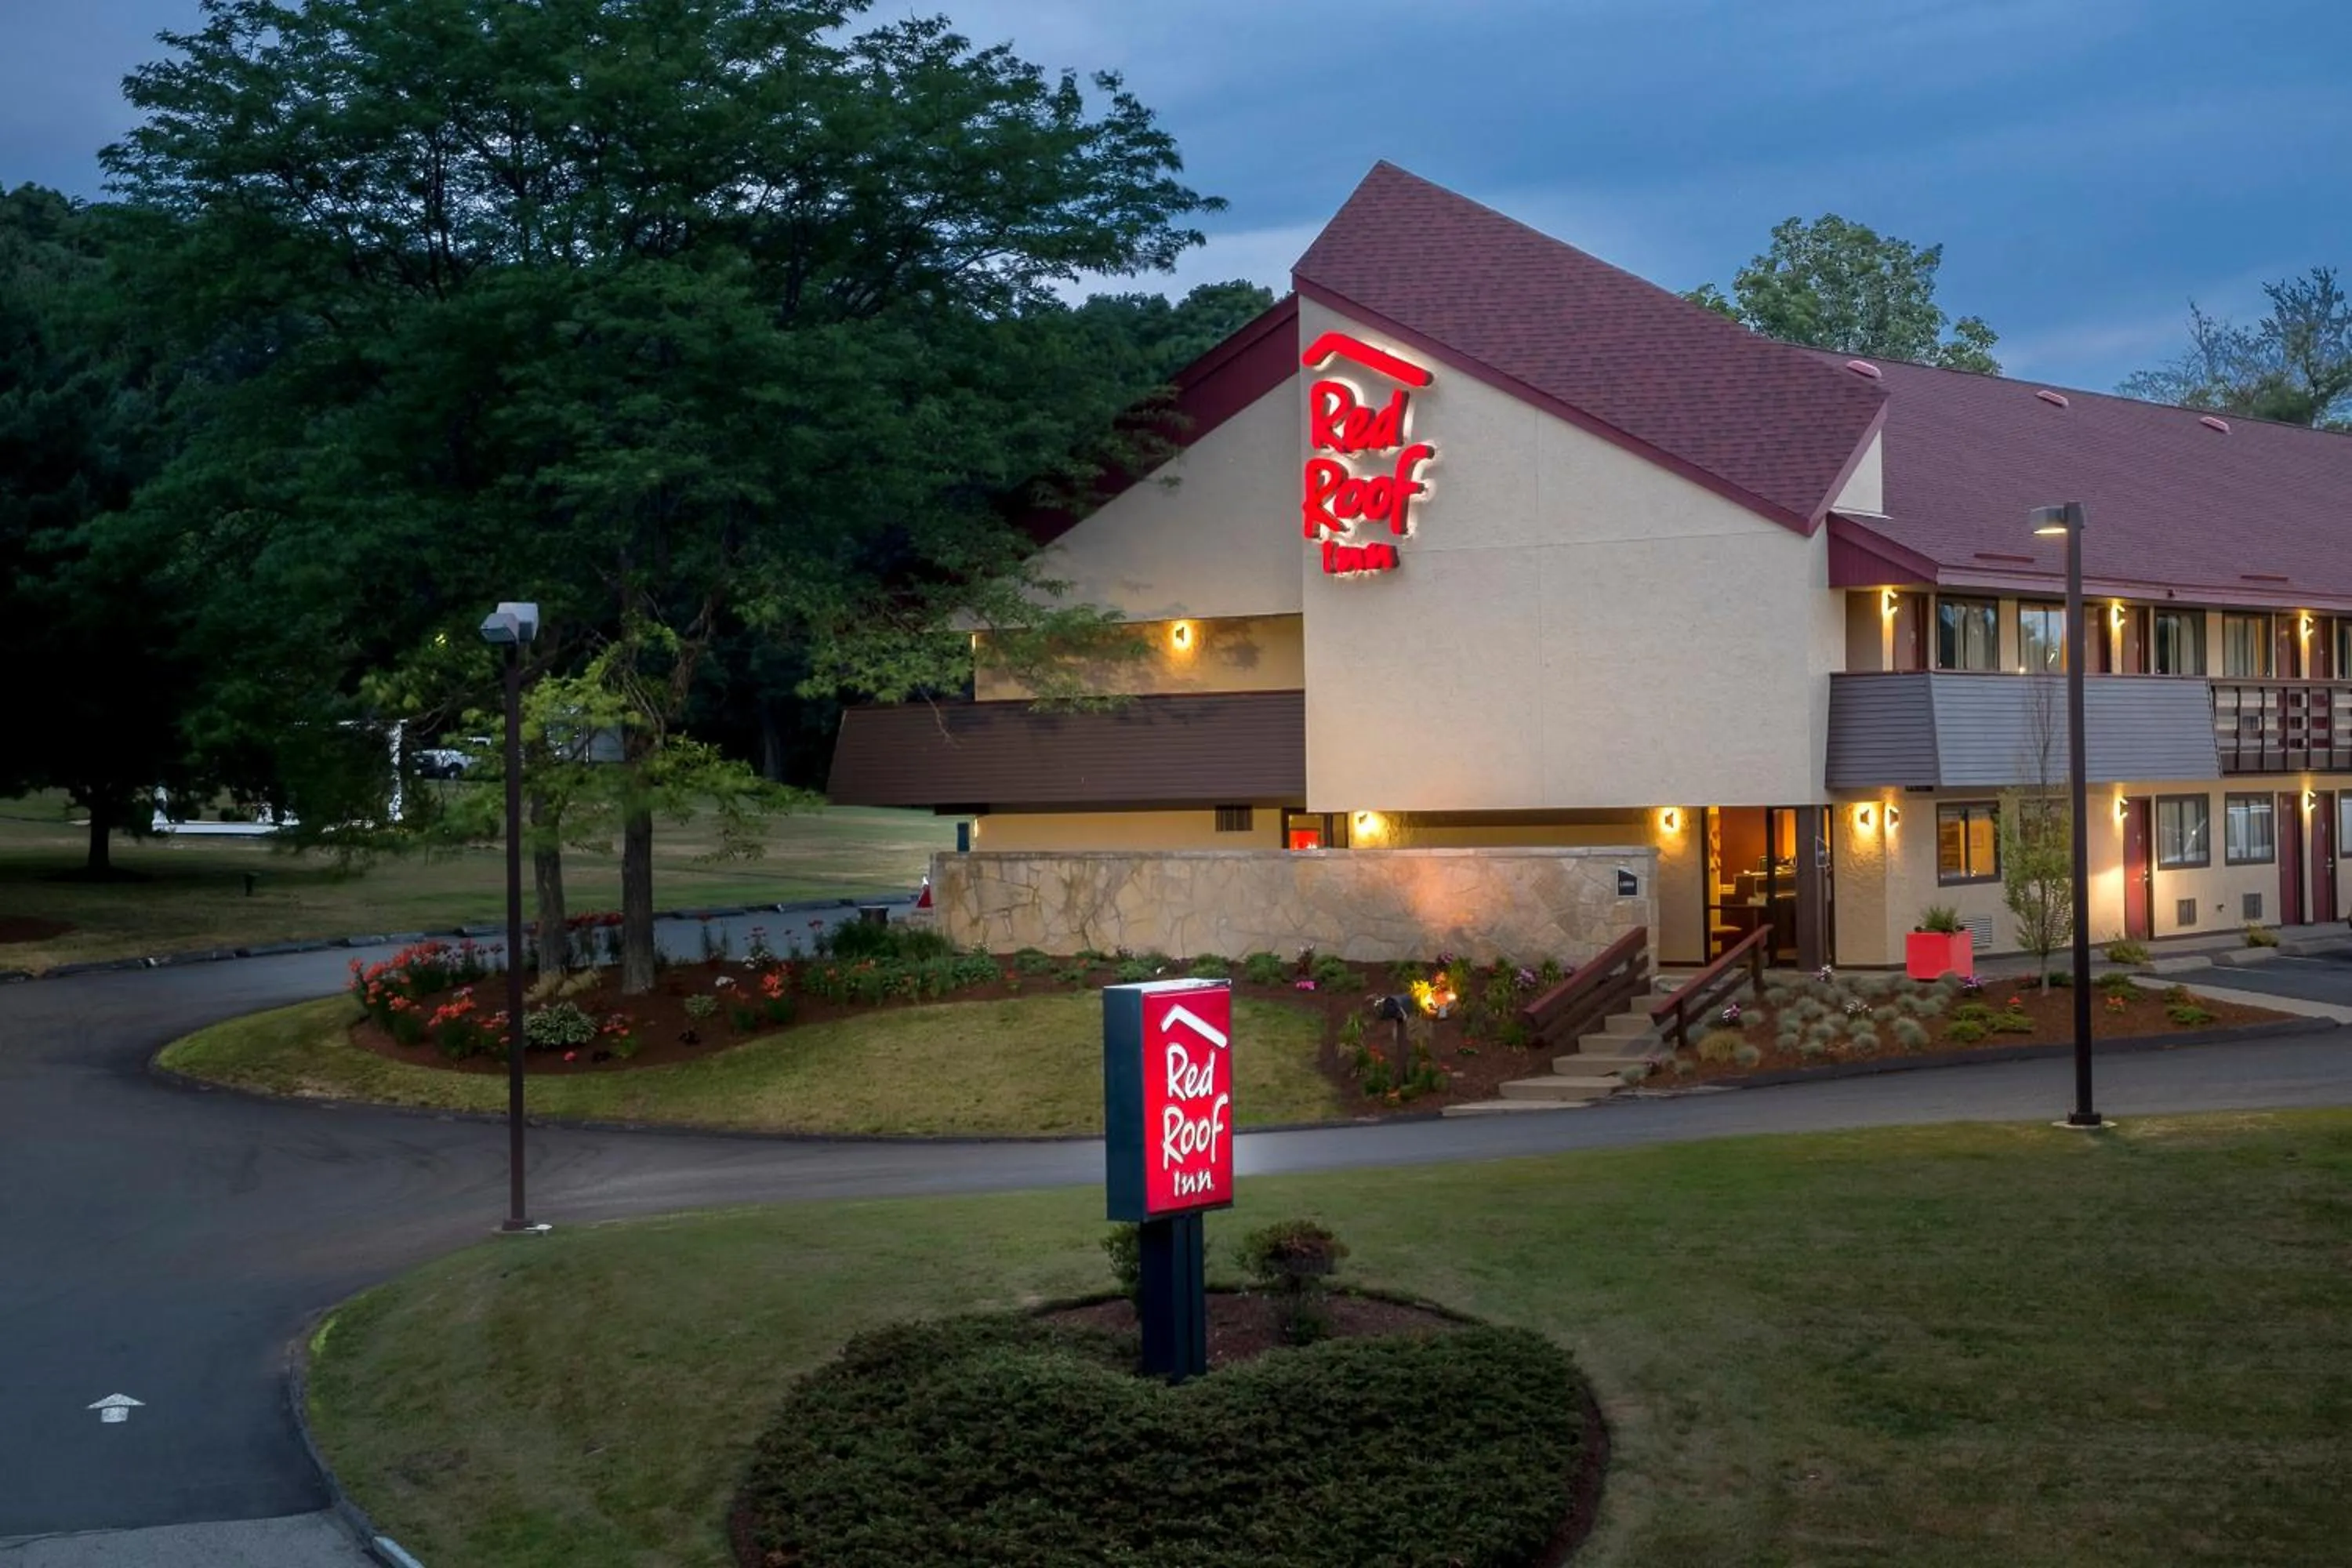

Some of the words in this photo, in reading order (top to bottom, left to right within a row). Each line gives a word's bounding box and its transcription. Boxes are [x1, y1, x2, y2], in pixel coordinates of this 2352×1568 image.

[1310, 379, 1410, 454] Red
[1302, 443, 1435, 539] Roof
[1323, 540, 1399, 574] Inn
[1166, 1042, 1215, 1101] Red
[1162, 1094, 1229, 1171] Roof
[1173, 1167, 1214, 1197] Inn
